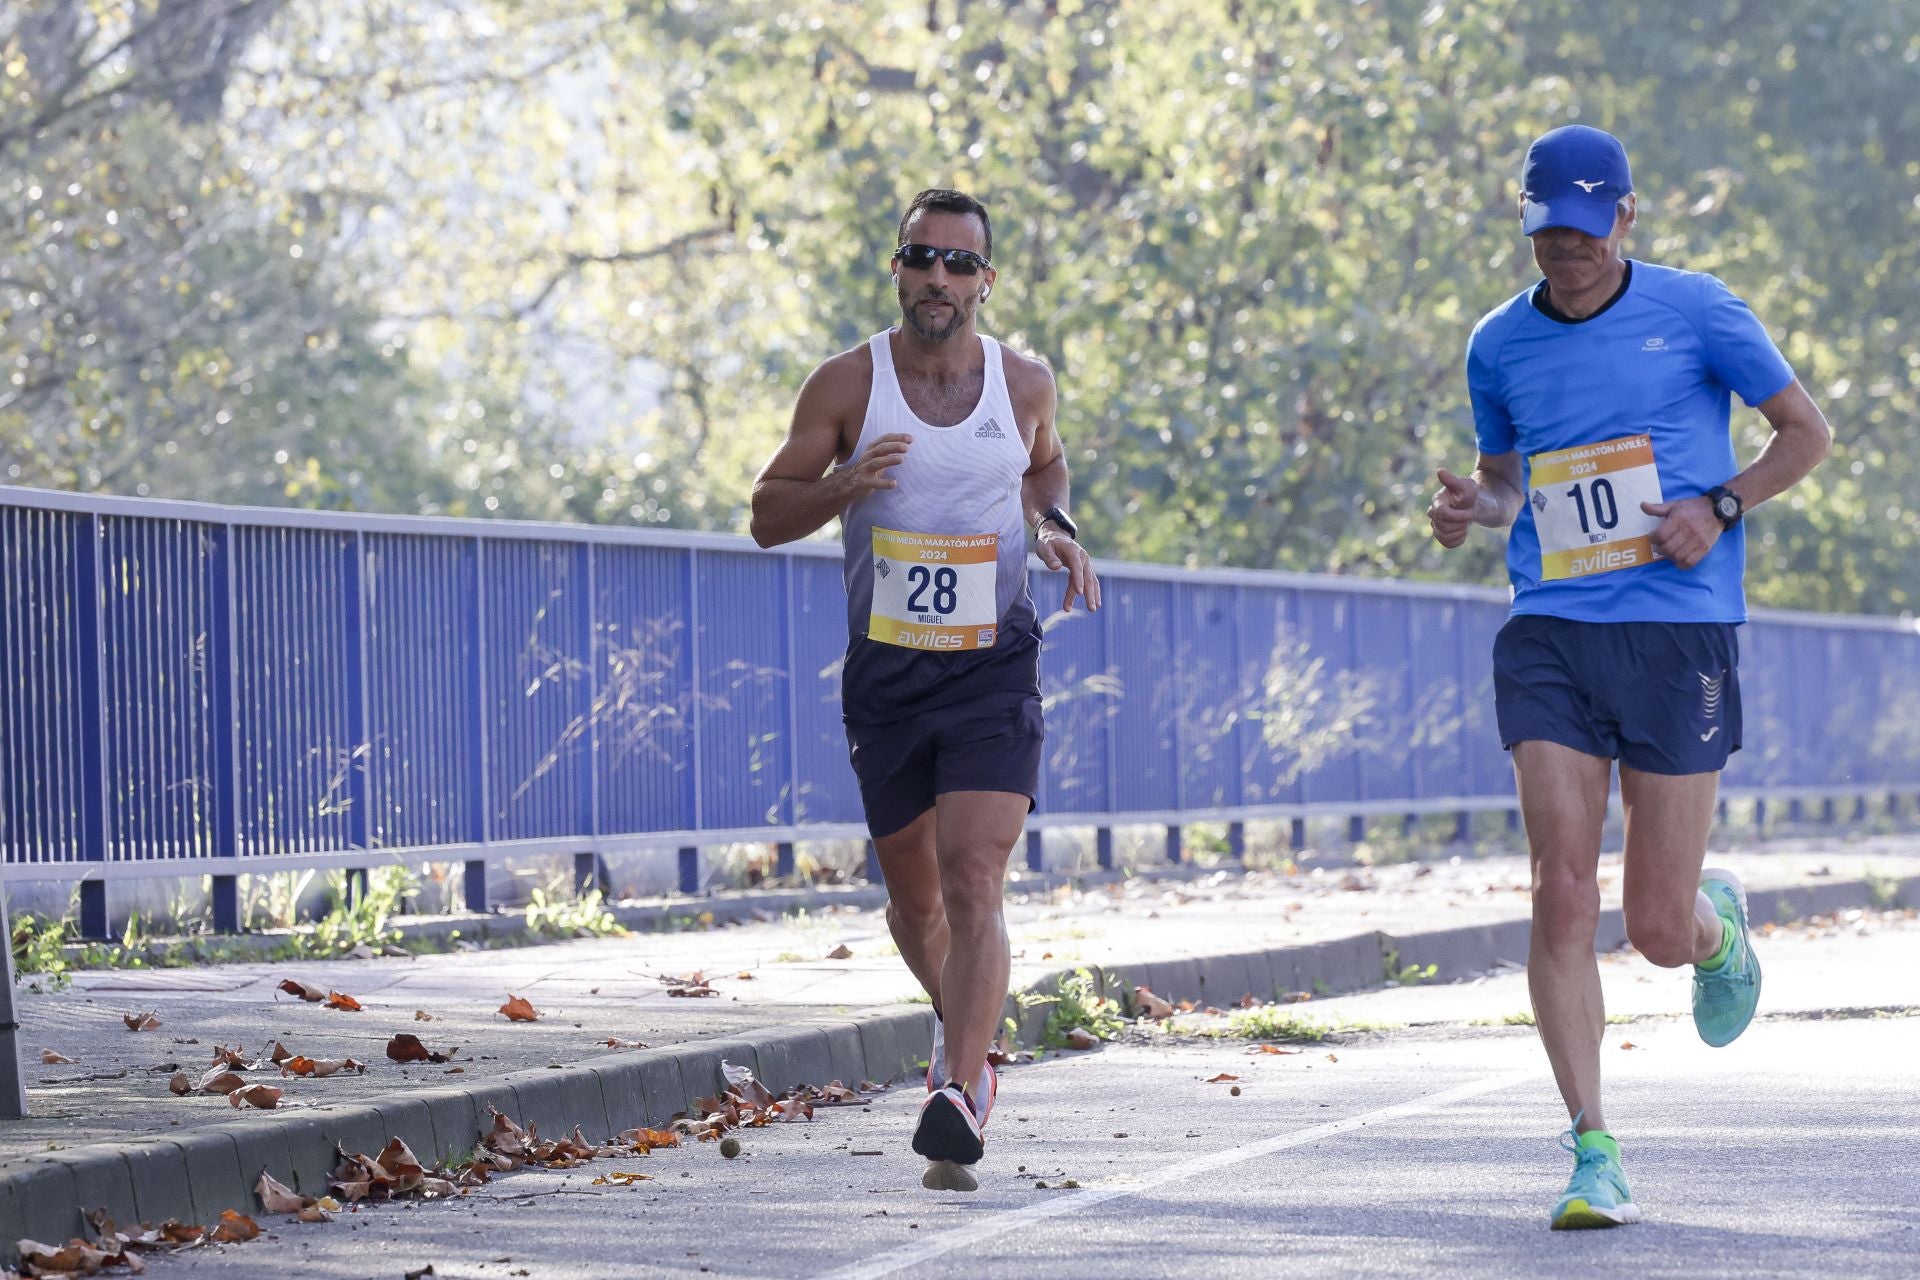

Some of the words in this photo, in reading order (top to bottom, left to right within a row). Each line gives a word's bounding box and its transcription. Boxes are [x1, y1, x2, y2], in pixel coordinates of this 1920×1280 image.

[975, 430, 1006, 440] adidas
[1571, 444, 1615, 460] MARATÓN
[1616, 437, 1649, 452] AVILÉS
[1569, 461, 1598, 476] 2024
[1566, 478, 1619, 534] 10
[896, 536, 923, 546] MEDIA
[925, 537, 969, 548] MARATÓN
[969, 535, 995, 548] AVILÉS
[919, 550, 948, 560] 2024
[907, 565, 958, 615] 28
[917, 614, 944, 625] MIGUEL
